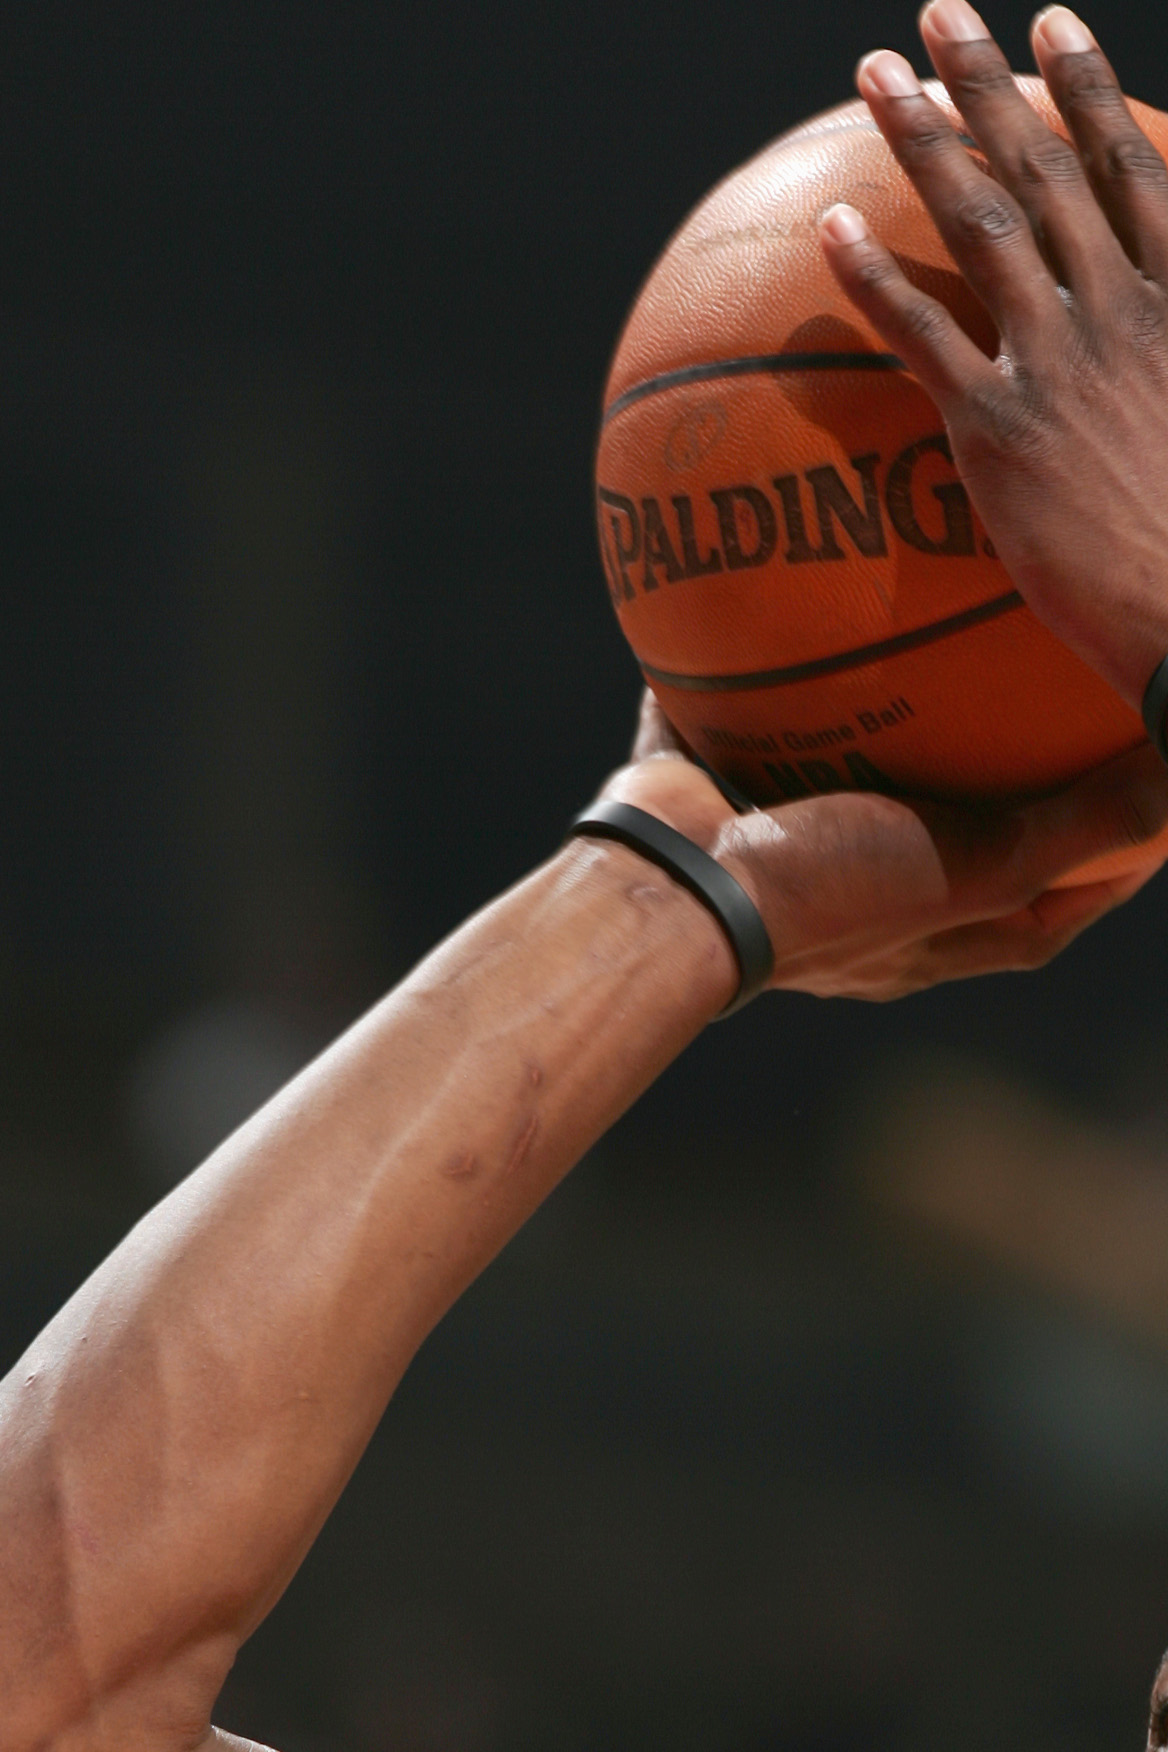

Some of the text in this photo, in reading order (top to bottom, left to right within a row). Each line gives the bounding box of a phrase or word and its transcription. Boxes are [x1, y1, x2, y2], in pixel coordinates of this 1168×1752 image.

[598, 433, 976, 608] PALDING
[782, 724, 857, 752] Game
[857, 697, 916, 735] Ball
